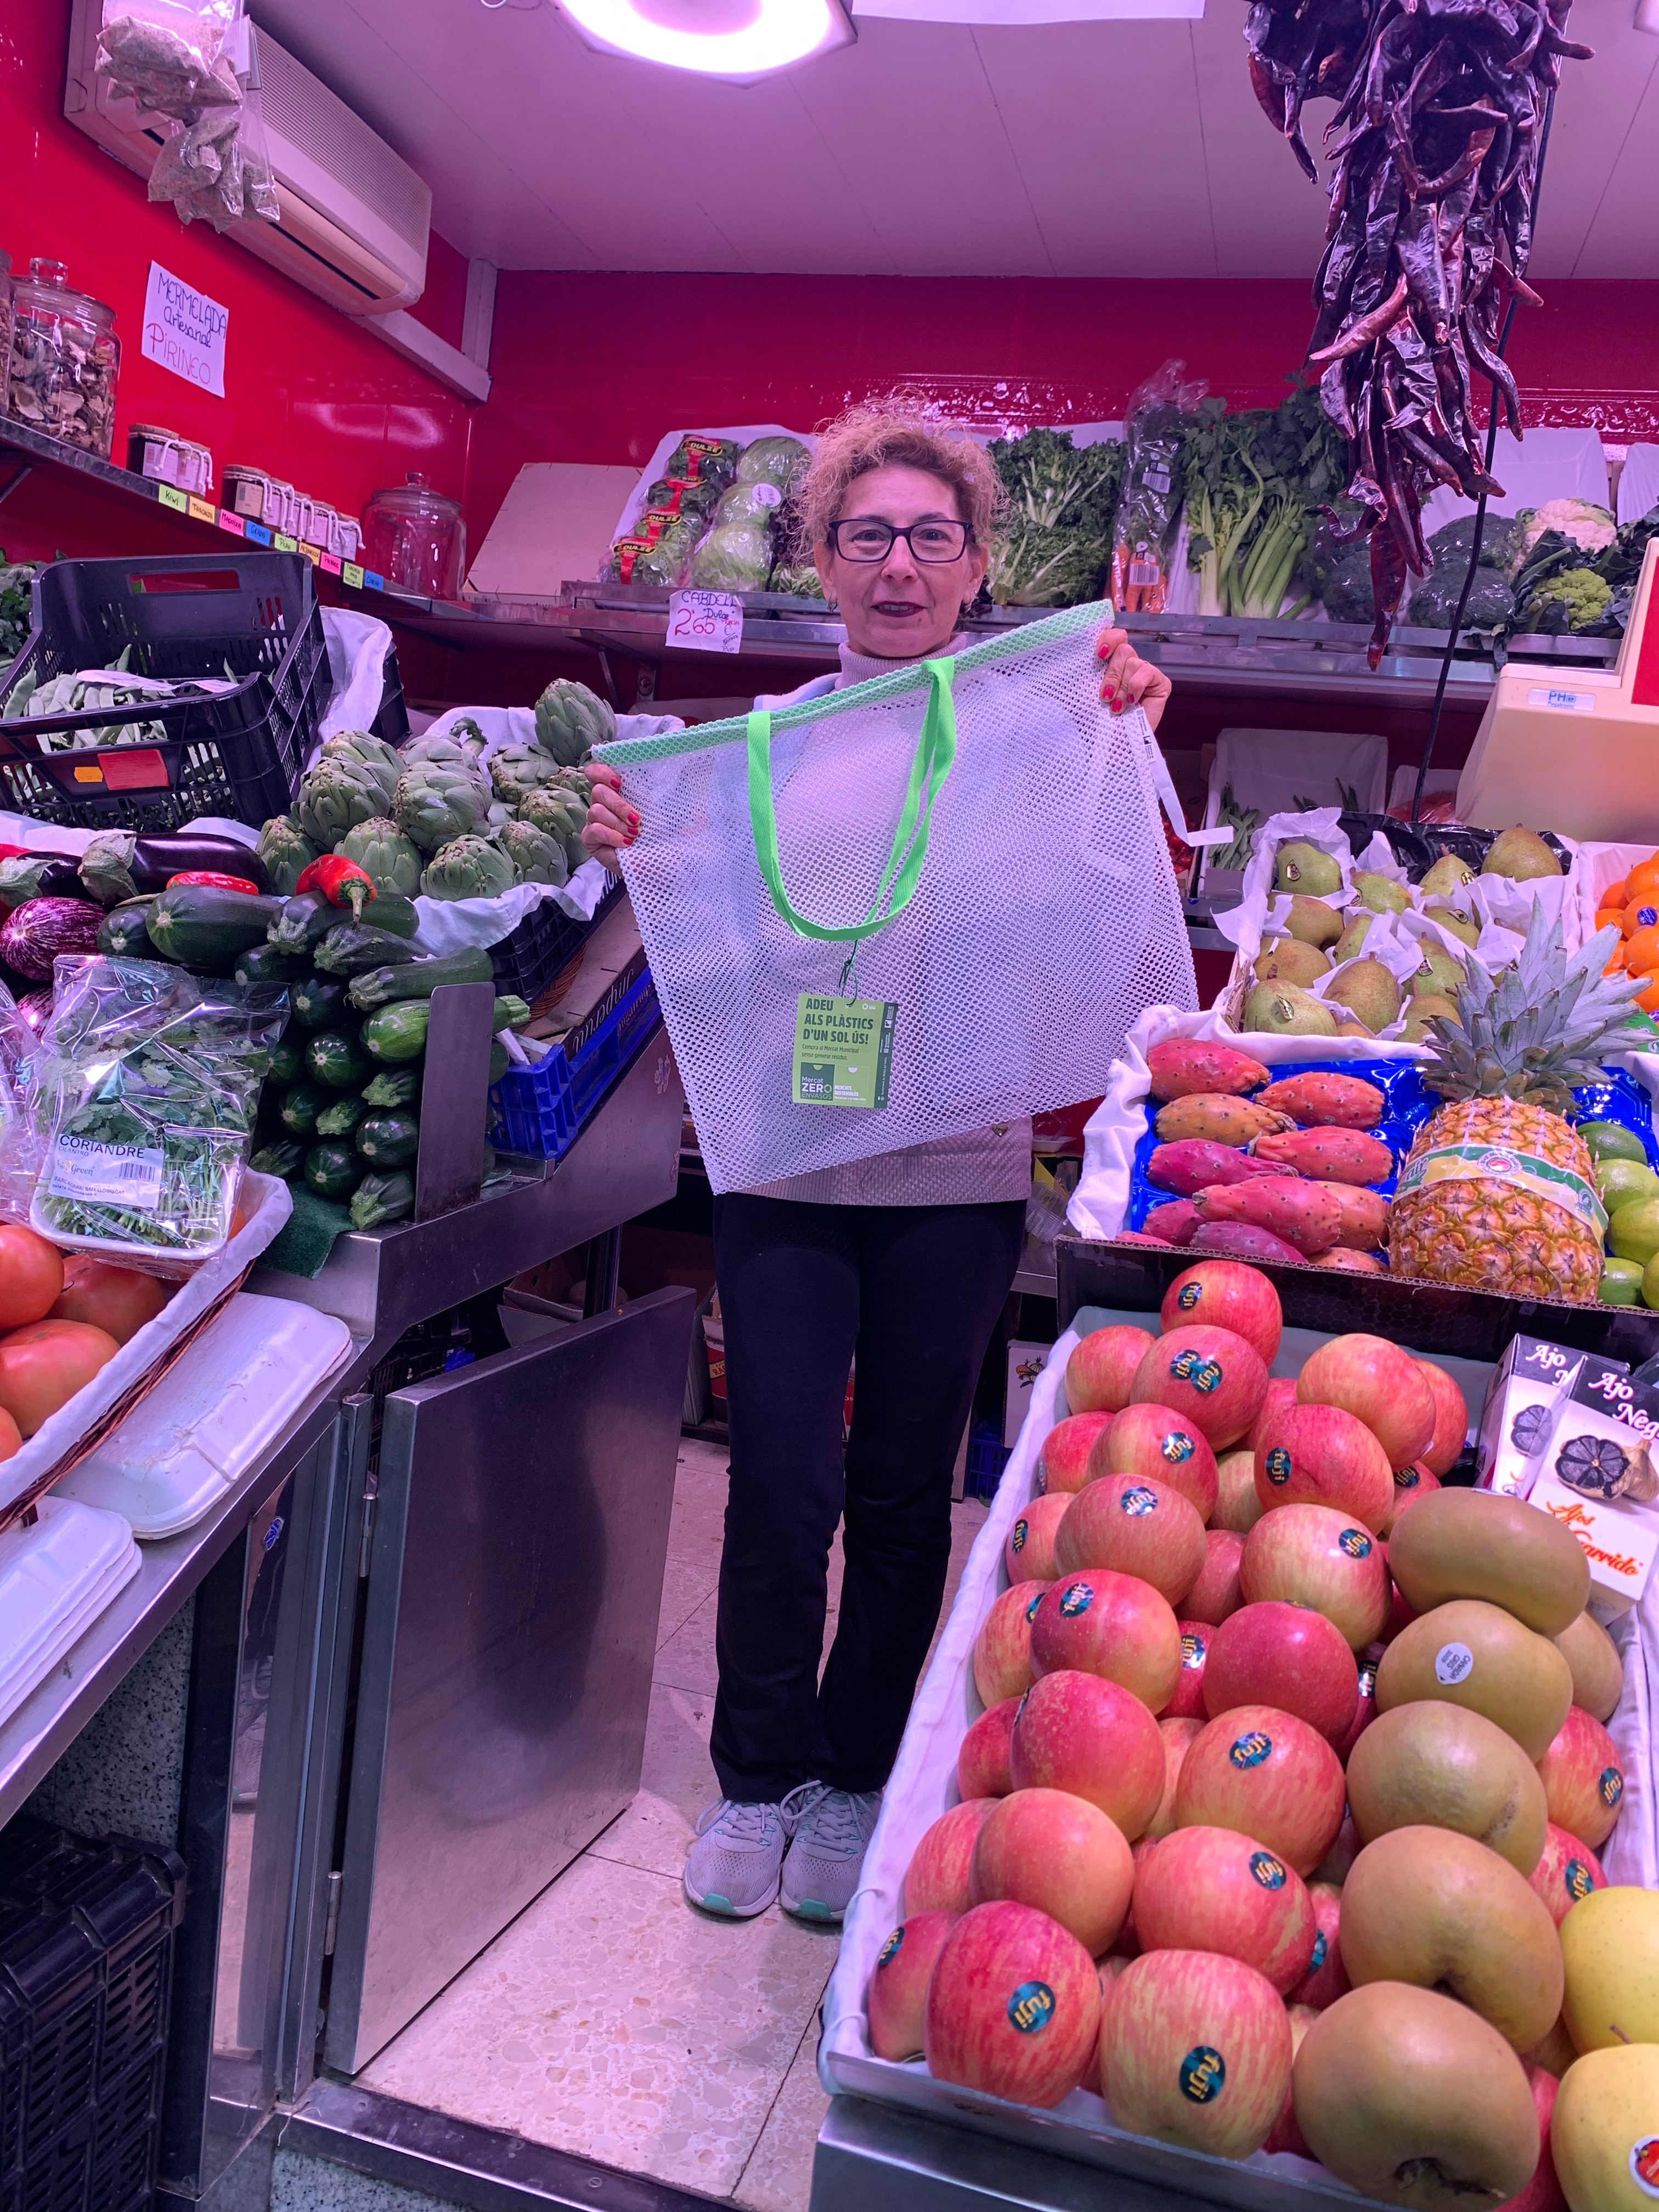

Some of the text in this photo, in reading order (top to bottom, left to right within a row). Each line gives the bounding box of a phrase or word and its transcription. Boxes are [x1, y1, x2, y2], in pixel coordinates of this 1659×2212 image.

[157, 272, 227, 339] MERMELADA
[681, 590, 737, 607] CABDELL
[805, 998, 834, 1011] ADEU
[804, 1013, 874, 1030] ALS PLÀSTICS
[802, 1044, 819, 1052] Compra
[831, 1031, 849, 1043] SOL
[852, 1030, 869, 1045] ÚS!
[802, 1082, 832, 1094] ZERO
[58, 1146, 89, 1156] CILANTRO
[60, 1135, 145, 1159] CORIANDRE
[54, 1176, 67, 1185] PARC
[1183, 1284, 1197, 1307] fuji
[1176, 1352, 1197, 1378] fuji
[1525, 1344, 1567, 1369] Ajo
[1197, 1364, 1220, 1391] fuji
[1588, 1371, 1635, 1401] Ajo
[1169, 1437, 1192, 1459] fuji
[1273, 1451, 1285, 1481] fuji
[1346, 1533, 1368, 1555] fuji
[1447, 1654, 1460, 1670] GRIS
[1449, 1655, 1471, 1680] CANADA
[1234, 1737, 1266, 1762] fuji
[1255, 1860, 1284, 1884] fuji
[1014, 1989, 1051, 2029] fuji
[1188, 2053, 1220, 2099] fuji
